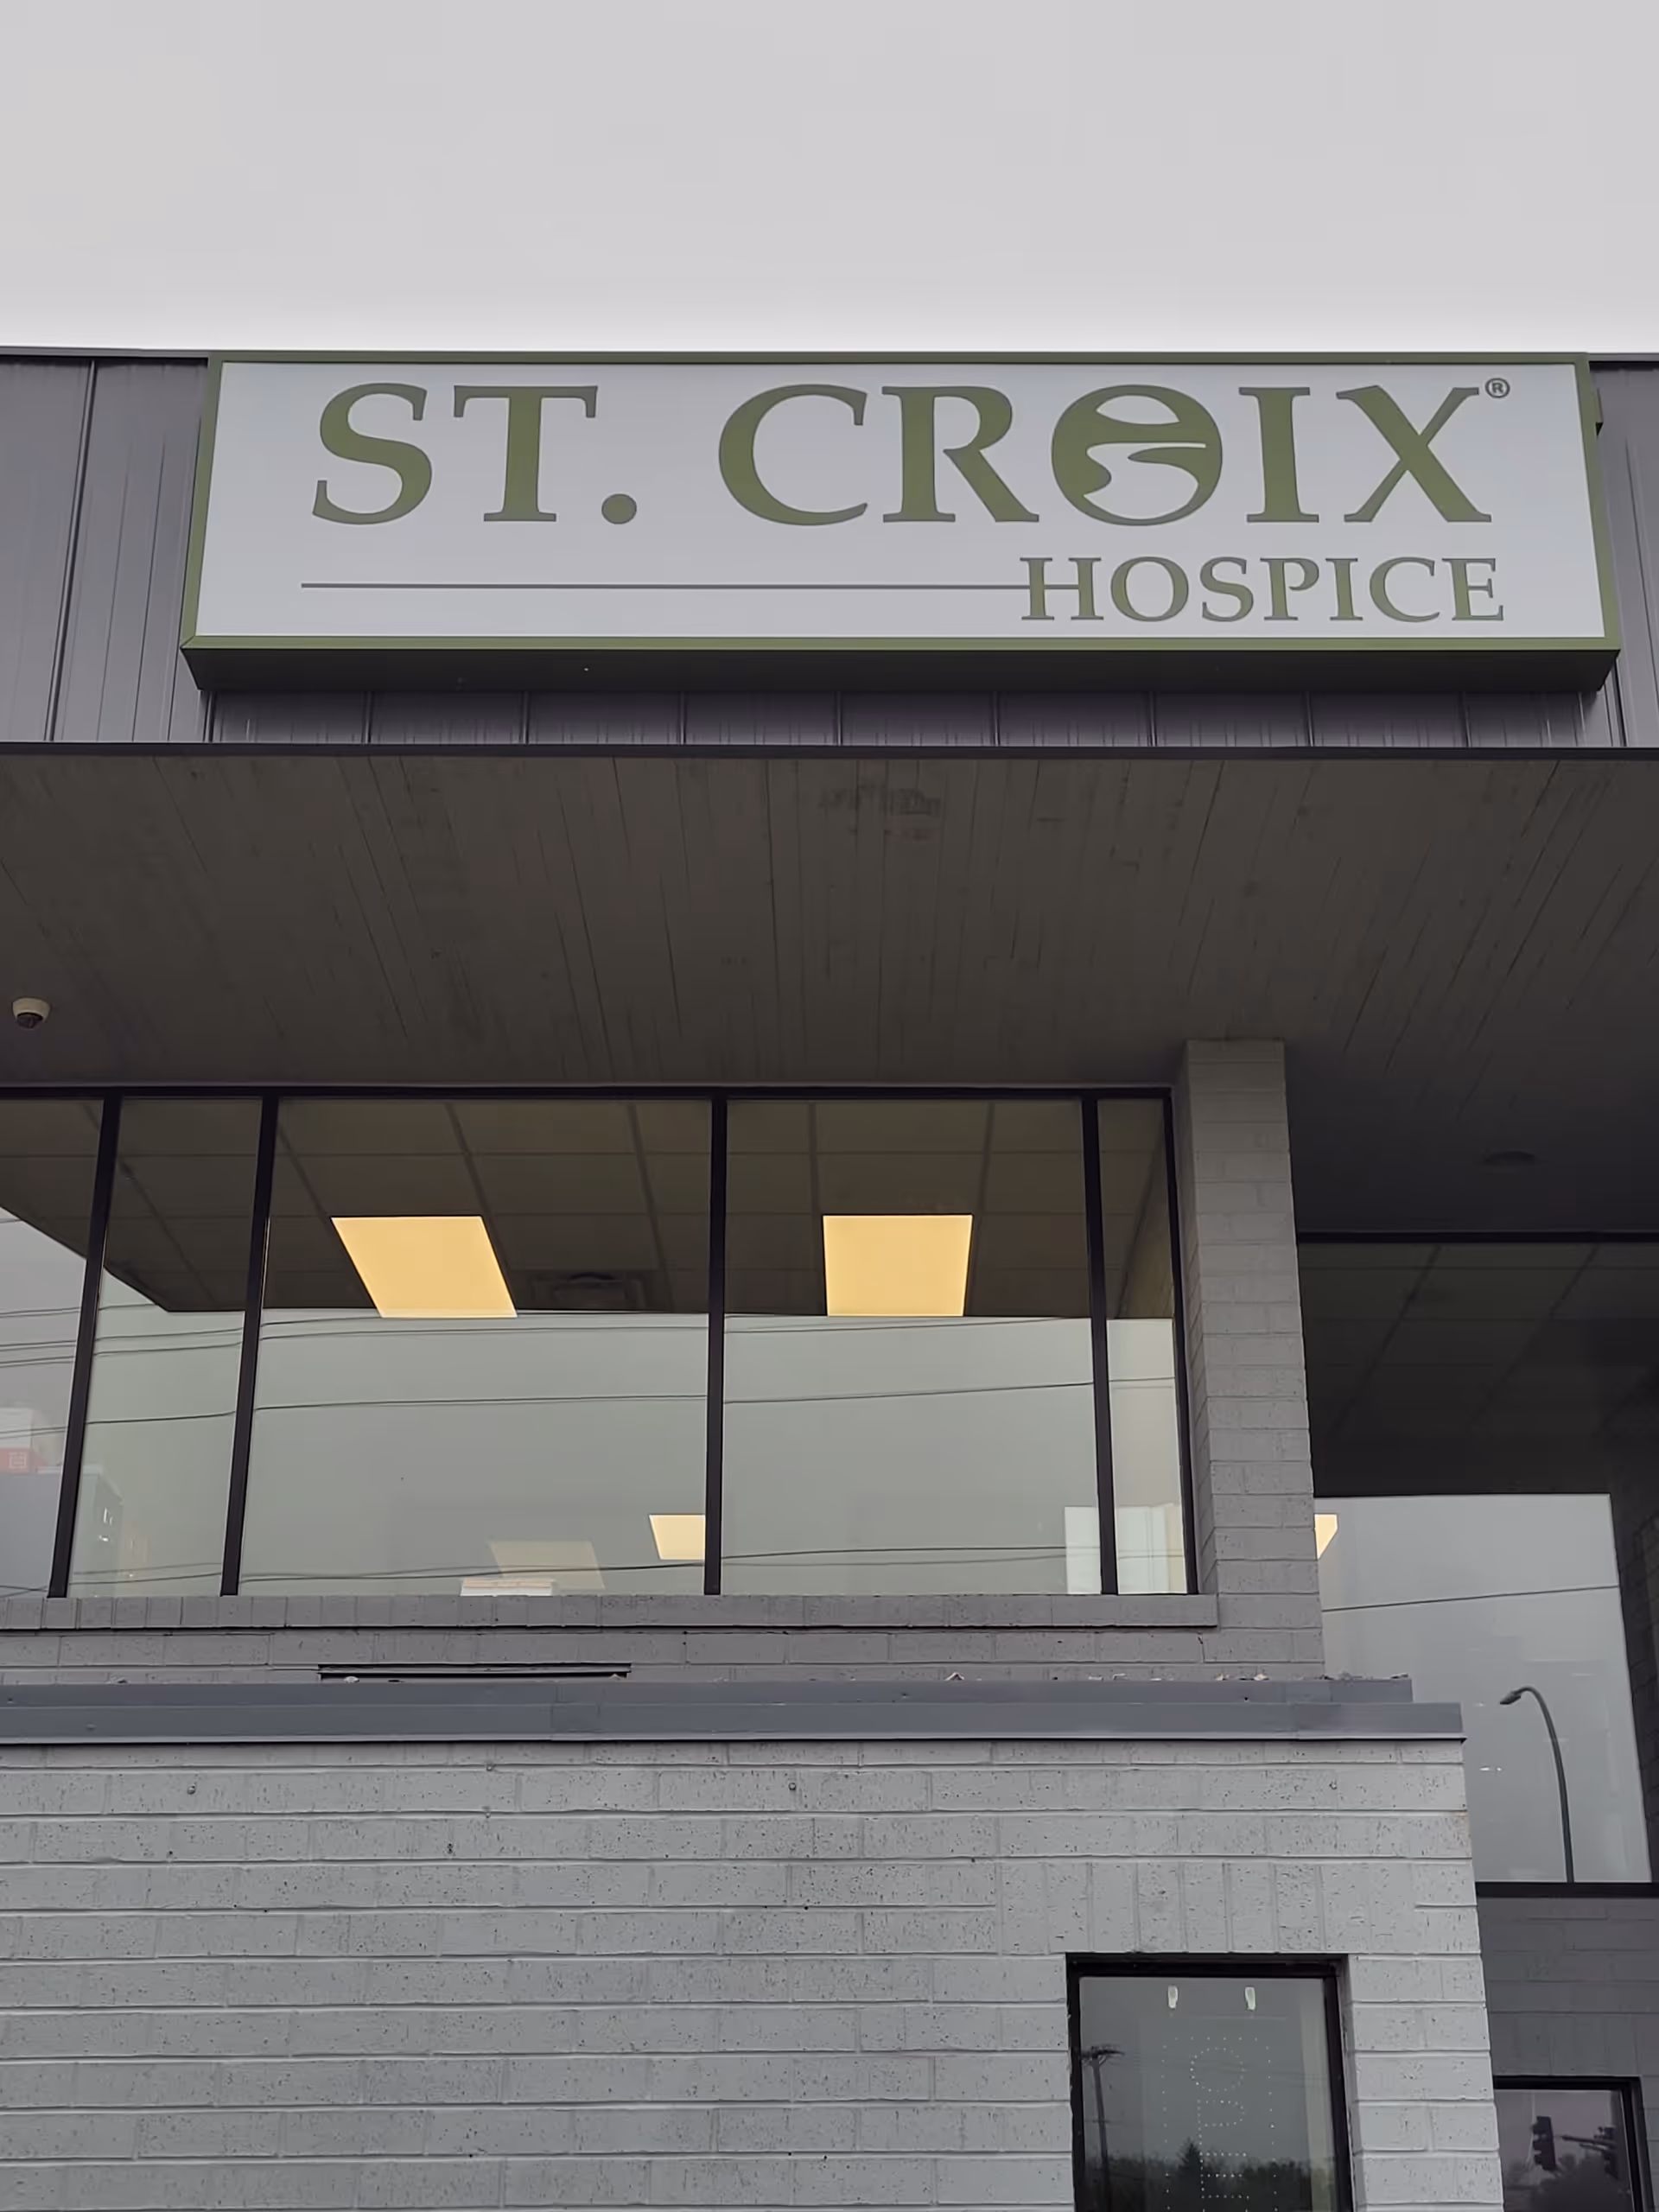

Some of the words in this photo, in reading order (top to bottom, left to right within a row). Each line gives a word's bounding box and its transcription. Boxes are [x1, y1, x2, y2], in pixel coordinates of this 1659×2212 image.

[312, 383, 638, 526] ST.
[1020, 556, 1503, 622] HOSPICE
[1189, 2045, 1250, 2212] OPE
